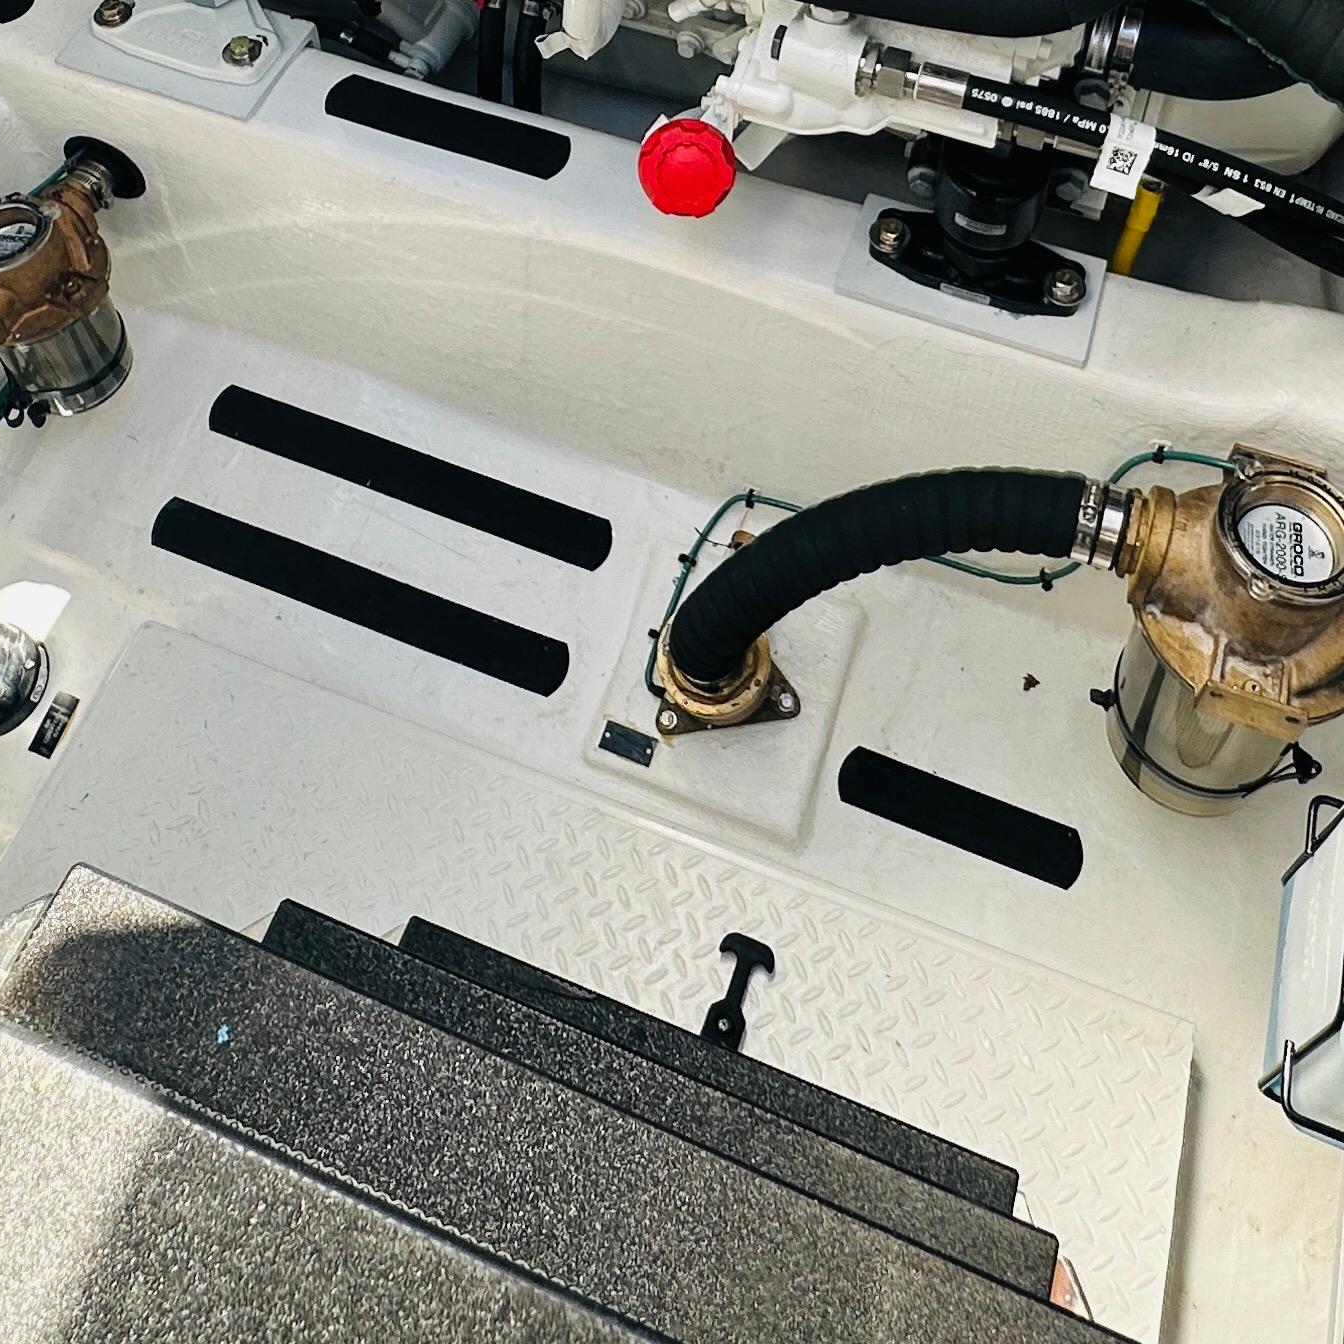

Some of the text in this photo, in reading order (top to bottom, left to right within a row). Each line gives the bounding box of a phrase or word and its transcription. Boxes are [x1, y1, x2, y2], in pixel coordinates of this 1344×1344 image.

[970, 88, 999, 104] 0575
[1016, 99, 1034, 112] psi
[1071, 115, 1099, 133] MPa
[1181, 152, 1196, 164] ID
[1292, 521, 1305, 577] GROCO
